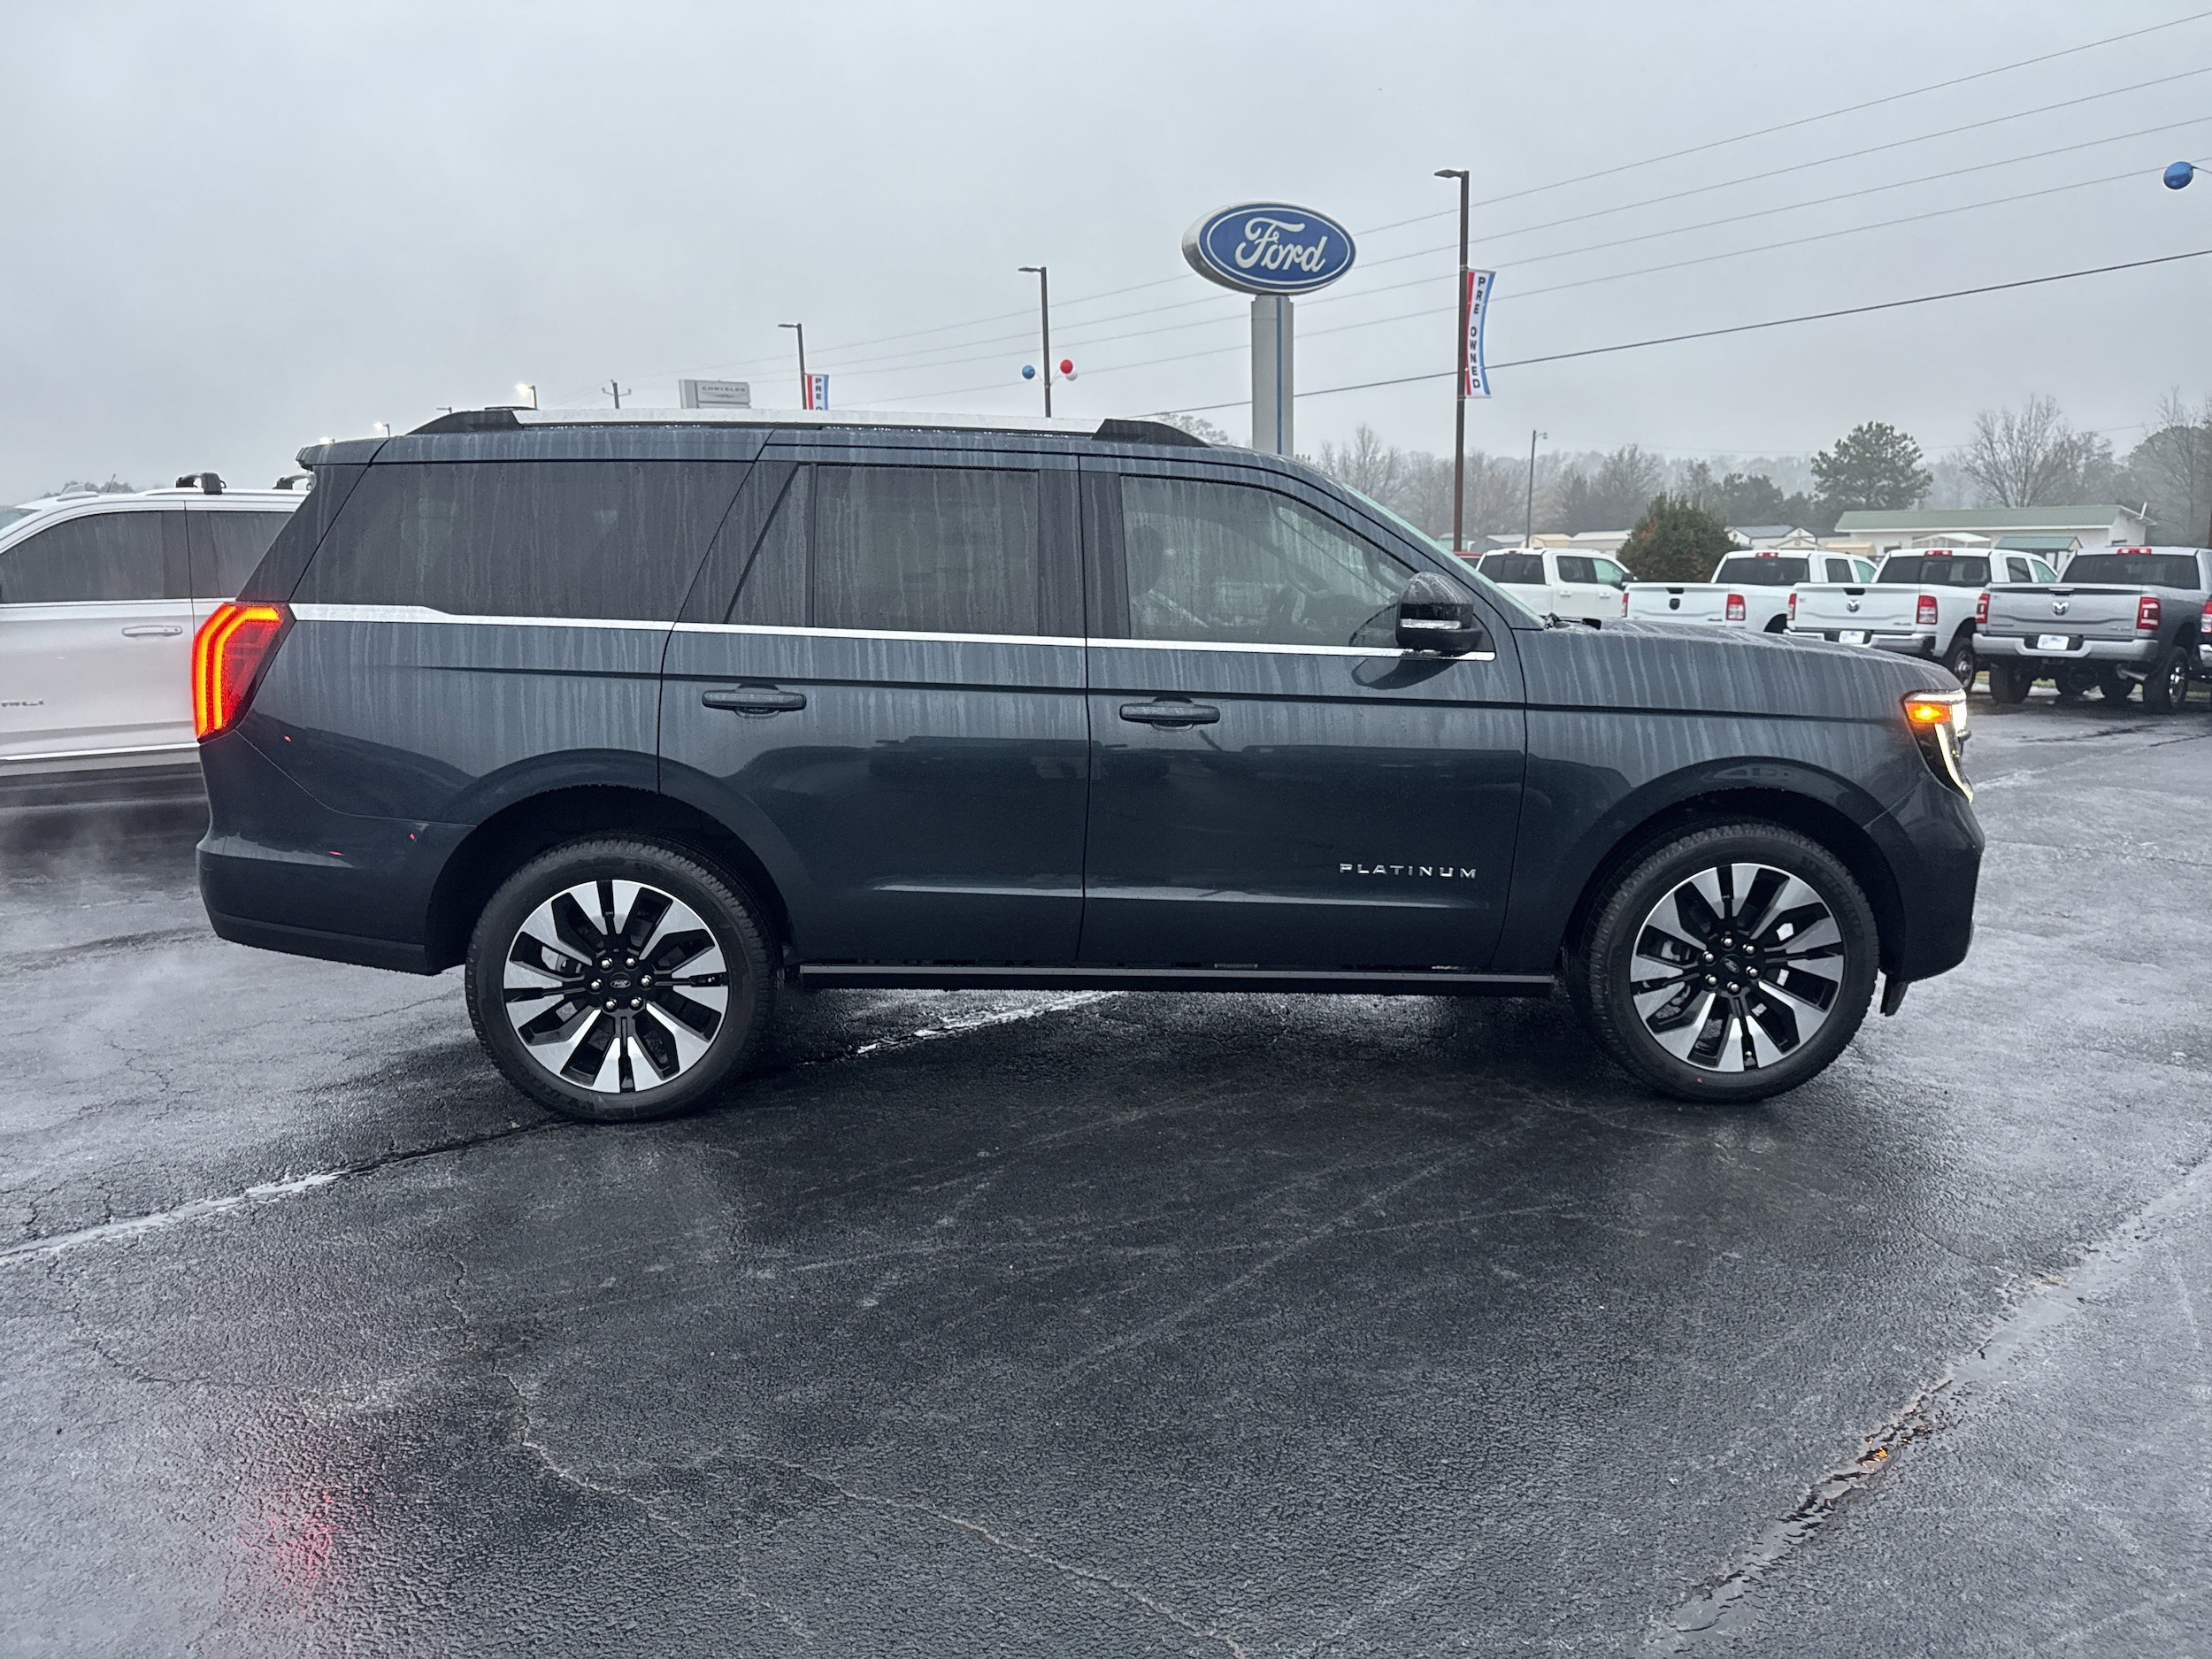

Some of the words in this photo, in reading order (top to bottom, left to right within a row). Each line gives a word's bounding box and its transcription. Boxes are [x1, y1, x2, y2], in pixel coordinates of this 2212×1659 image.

[1235, 217, 1328, 273] Ford
[1473, 276, 1486, 314] PRE
[1469, 326, 1481, 388] OWNED
[1339, 863, 1477, 879] PLATINUM
